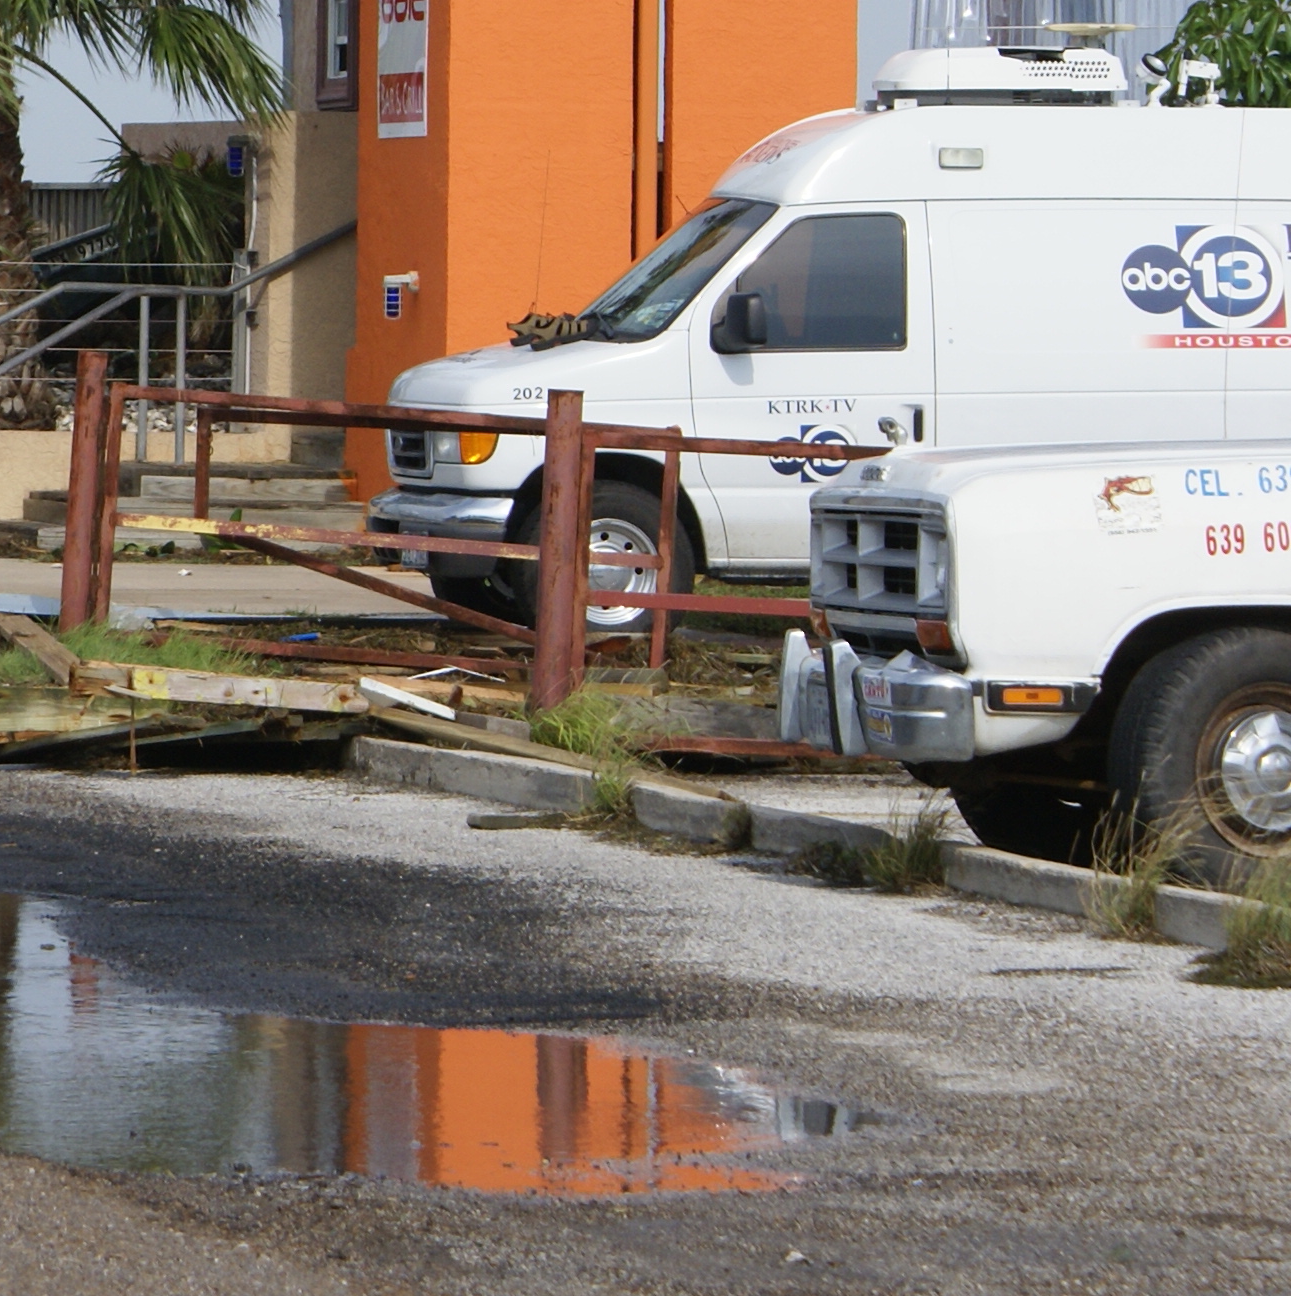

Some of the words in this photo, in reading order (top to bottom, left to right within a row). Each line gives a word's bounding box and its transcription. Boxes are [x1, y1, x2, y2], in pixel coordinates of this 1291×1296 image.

[1122, 262, 1191, 291] abc
[1193, 251, 1267, 300] 13
[513, 387, 543, 401] 202
[1258, 465, 1291, 493] 63
[1206, 524, 1245, 556] 639
